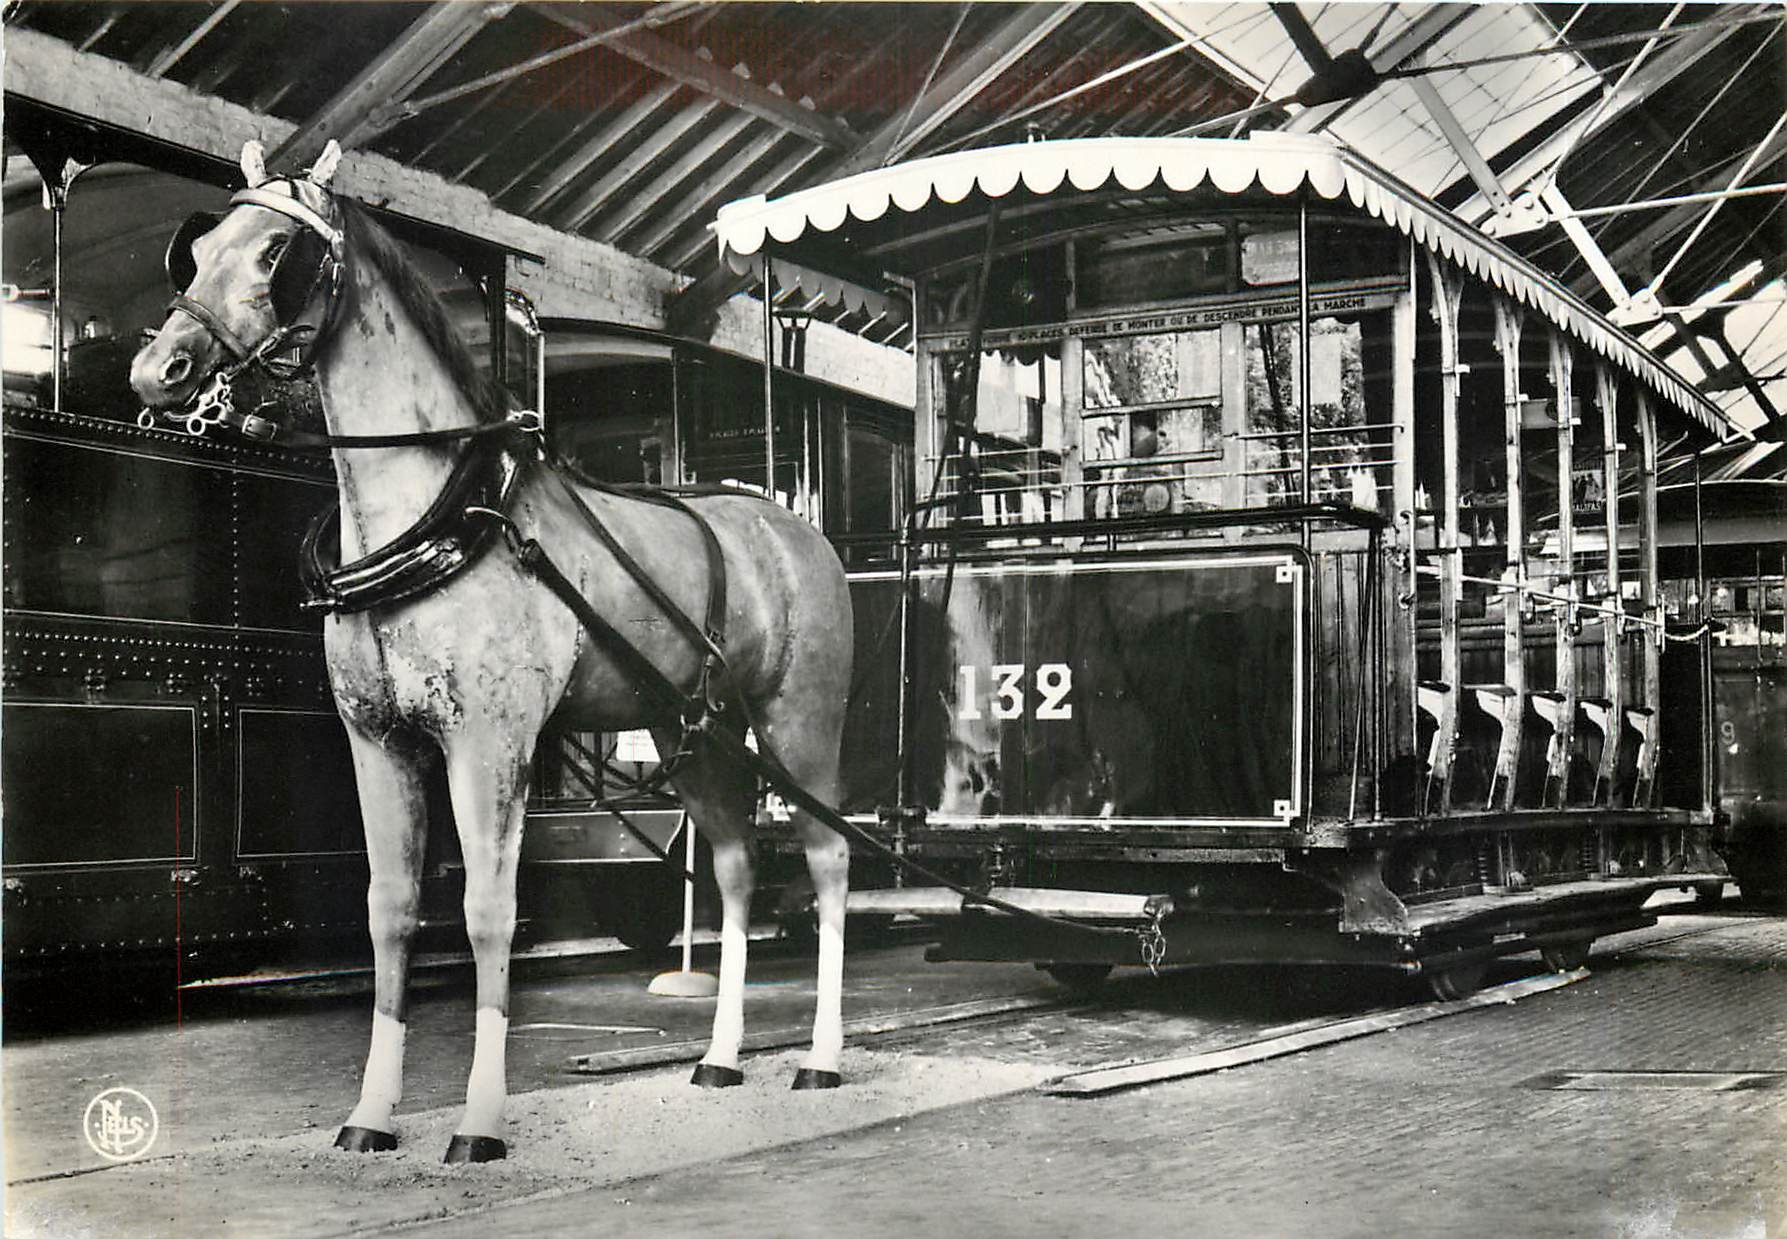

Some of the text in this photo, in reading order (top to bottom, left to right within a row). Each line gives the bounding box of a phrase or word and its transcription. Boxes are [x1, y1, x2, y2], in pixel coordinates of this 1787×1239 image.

[1112, 321, 1123, 332] DE
[1128, 318, 1165, 331] MONTER
[1170, 316, 1183, 326] OU
[1186, 314, 1197, 324] DE
[1204, 309, 1257, 322] DESCENDRE
[1324, 298, 1366, 311] MARCHE
[958, 664, 1072, 720] 132
